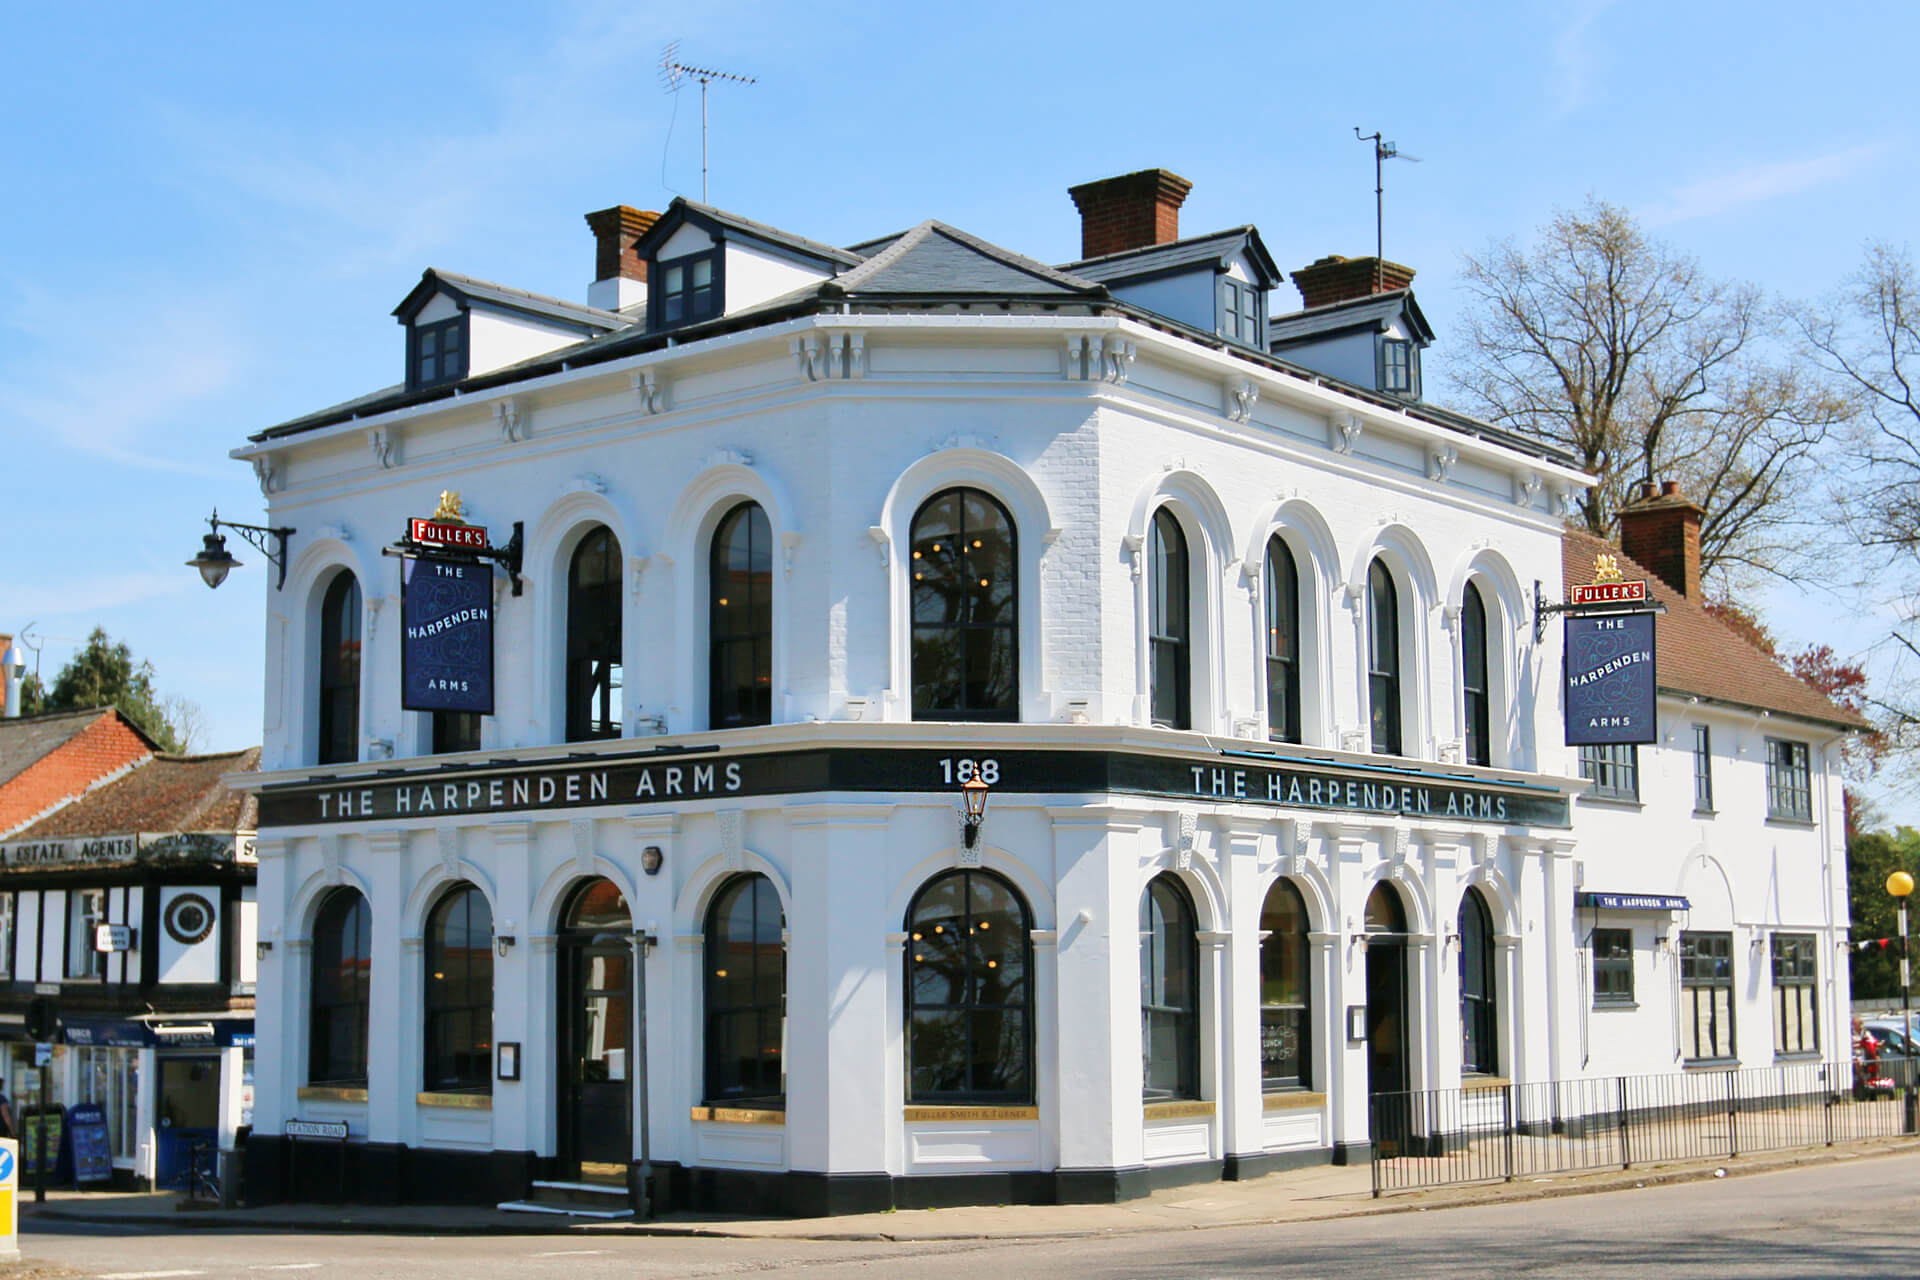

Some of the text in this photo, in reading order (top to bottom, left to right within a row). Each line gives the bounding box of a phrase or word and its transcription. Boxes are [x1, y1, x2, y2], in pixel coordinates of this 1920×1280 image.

[416, 521, 484, 546] FULLER'S
[435, 565, 464, 578] THE
[1574, 585, 1641, 601] FULLER'S
[408, 608, 488, 640] HARPENDEN
[1596, 619, 1625, 630] THE
[1569, 651, 1650, 688] HARPENDEN
[428, 679, 469, 692] ARMS
[1589, 717, 1631, 728] ARMS
[939, 758, 1000, 784] 188
[319, 761, 742, 818] THE HARPENDEN ARMS
[1190, 766, 1508, 819] THE HARPENDEN ARMS
[16, 843, 65, 861] ESTATE
[81, 839, 132, 858] AGENTS
[1603, 897, 1618, 907] THE
[1263, 1039, 1283, 1048] LUNCH
[950, 1110, 979, 1119] SMITH
[287, 1122, 344, 1137] STATION ROAD
